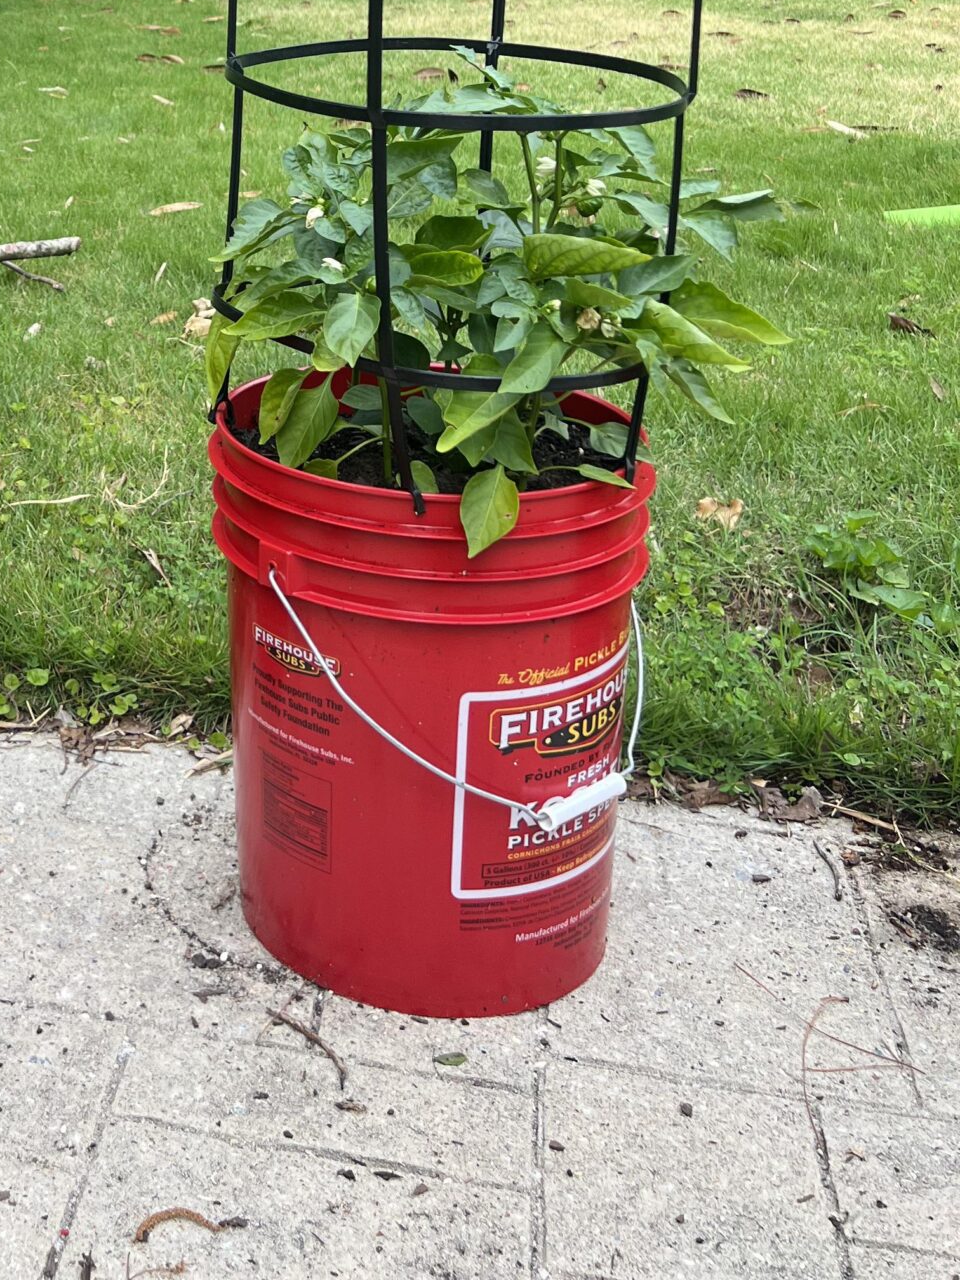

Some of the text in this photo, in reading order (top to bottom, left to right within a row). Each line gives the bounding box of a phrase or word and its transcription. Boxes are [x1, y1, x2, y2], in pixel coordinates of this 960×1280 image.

[254, 625, 337, 676] FIREHOUSE
[275, 648, 307, 671] SUBS
[497, 639, 617, 686] The Official PICKLE
[277, 678, 323, 708] Supporting
[325, 697, 344, 713] The
[282, 709, 331, 737] Foundation
[287, 697, 309, 716] Subs
[310, 707, 341, 726] Public
[567, 699, 617, 744] SUBS
[288, 734, 320, 754] Firehouse
[524, 752, 600, 784] FOUNDED BY
[567, 753, 611, 788] FRESH
[506, 815, 585, 851] PICKLE
[506, 842, 562, 861] CORNICHONS
[483, 878, 521, 887] Product
[522, 874, 532, 883] of
[533, 868, 550, 879] USA
[556, 860, 575, 874] Keep
[515, 920, 569, 944] Manufactured
[568, 914, 578, 926] for
